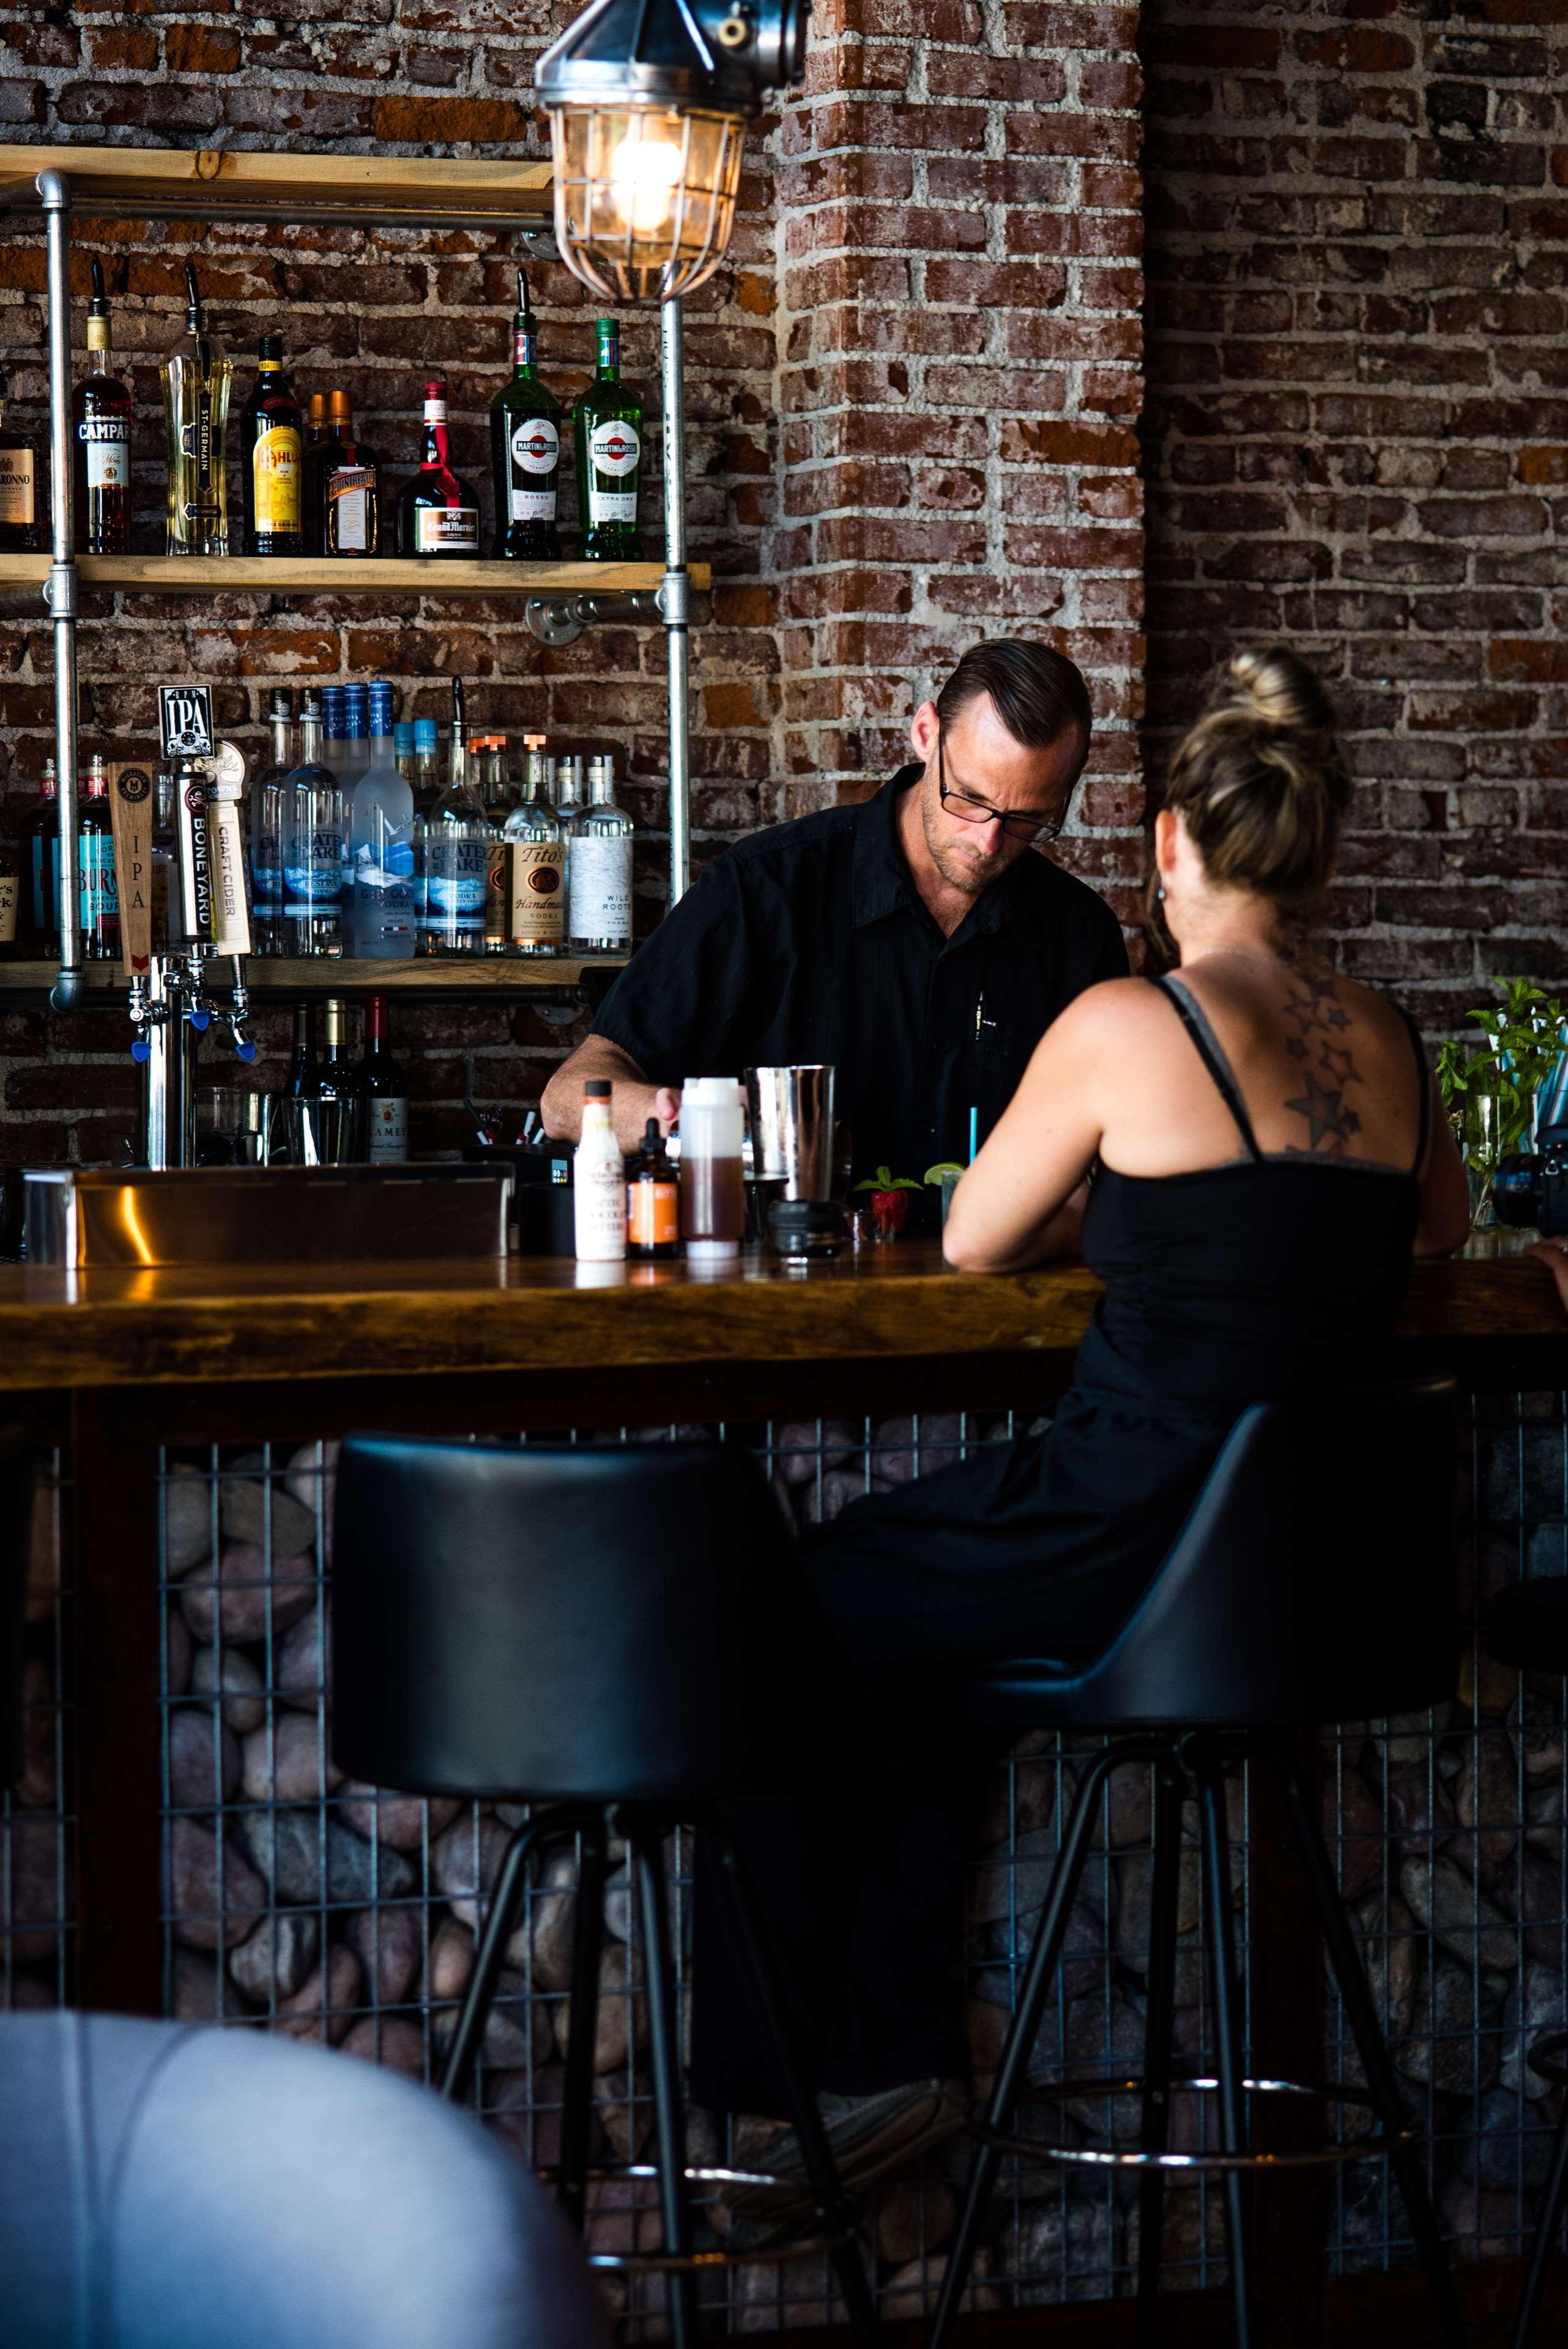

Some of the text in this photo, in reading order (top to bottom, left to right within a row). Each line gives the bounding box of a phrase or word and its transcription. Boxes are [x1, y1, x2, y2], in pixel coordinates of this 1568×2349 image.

[258, 445, 300, 469] KAHLÚ
[0, 474, 30, 485] RONNO
[175, 690, 196, 699] RPM
[167, 698, 207, 739] IPA
[522, 846, 564, 863] Tito's
[193, 817, 211, 925] BONEYARD
[218, 826, 236, 916] CRAFT CIDER
